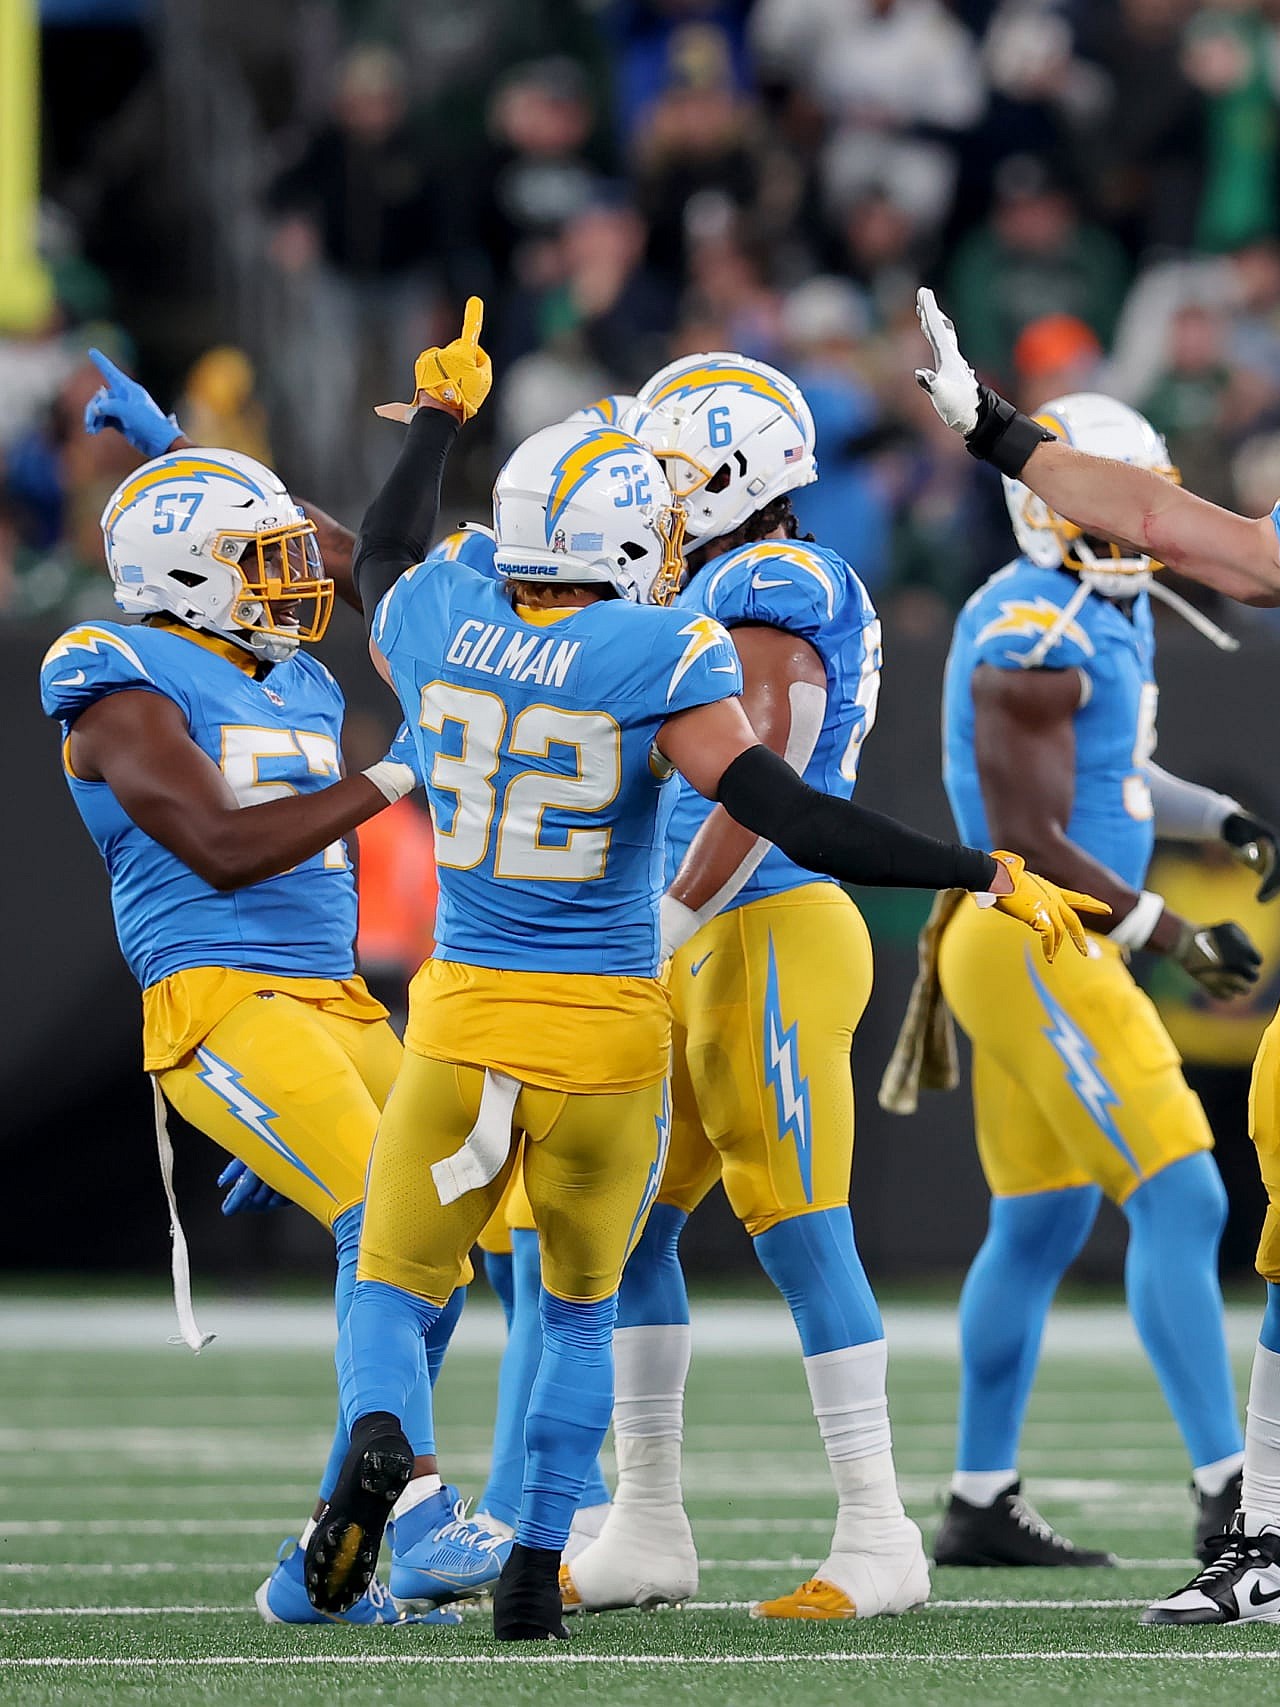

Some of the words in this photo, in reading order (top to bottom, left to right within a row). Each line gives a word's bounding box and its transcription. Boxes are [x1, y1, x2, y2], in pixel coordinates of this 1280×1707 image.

[707, 406, 732, 448] 6
[610, 462, 652, 508] 32
[153, 493, 204, 535] 57
[446, 619, 582, 688] GILMAN
[419, 679, 622, 882] 32
